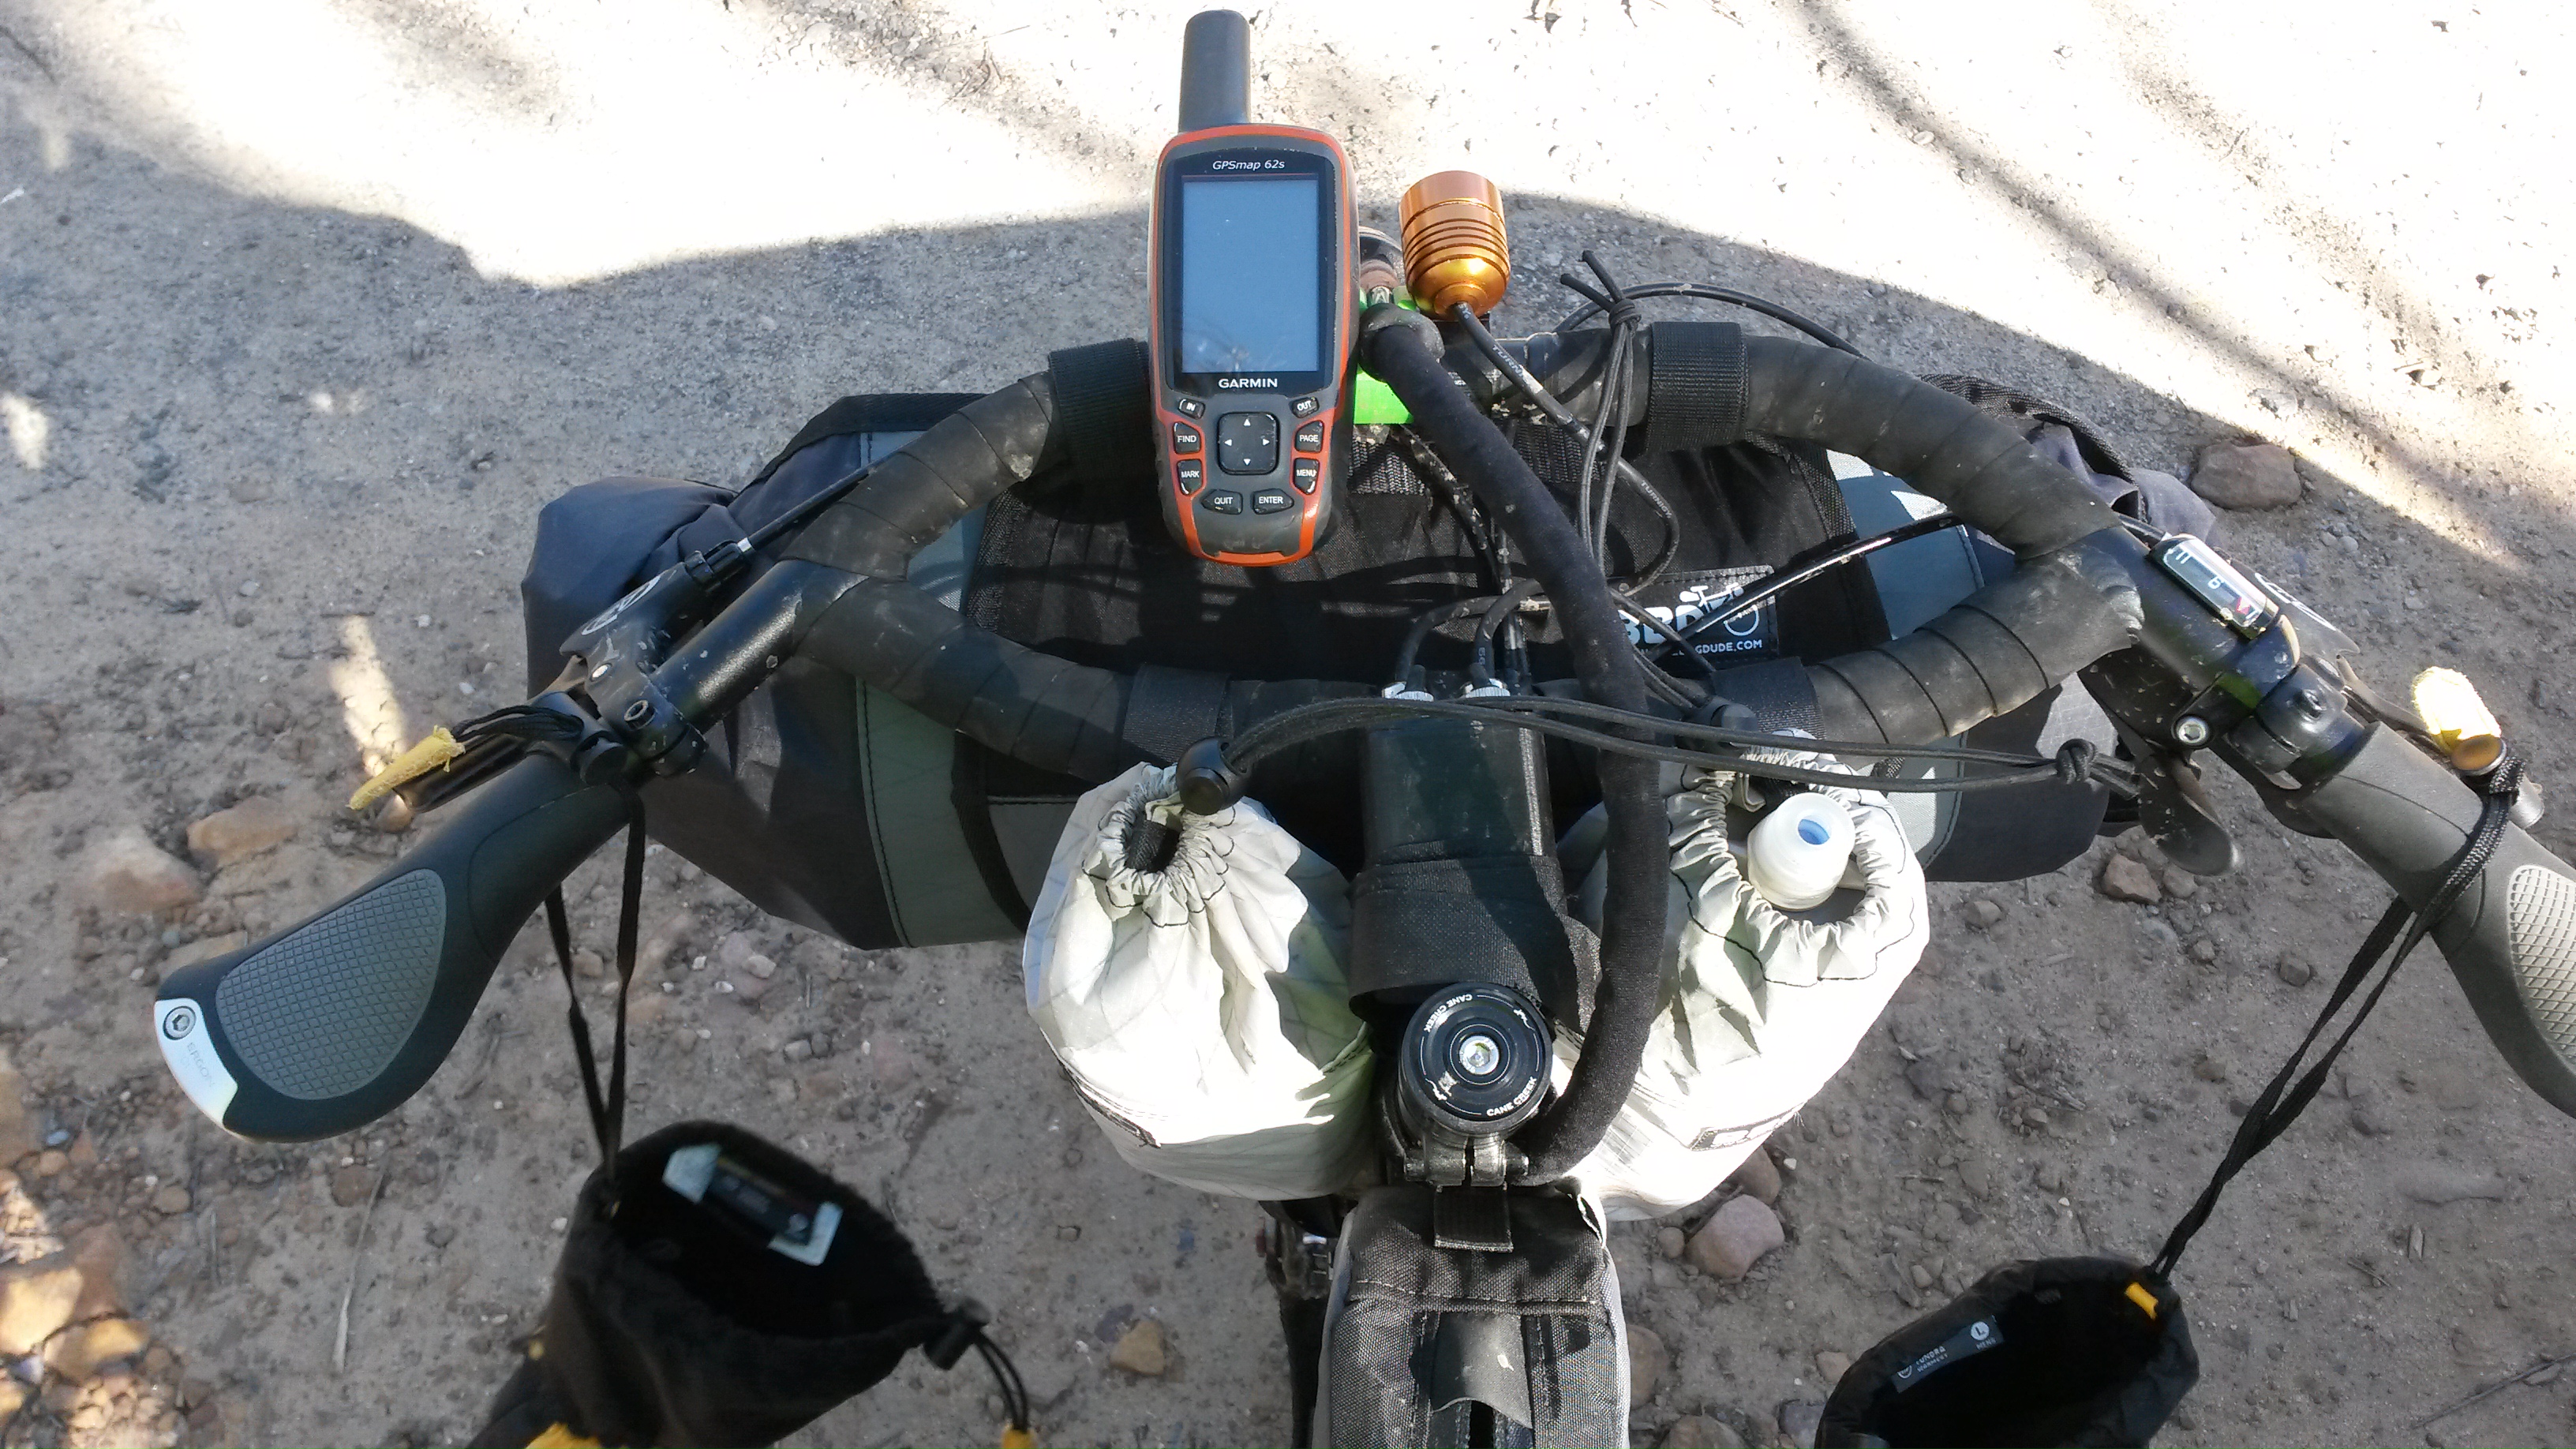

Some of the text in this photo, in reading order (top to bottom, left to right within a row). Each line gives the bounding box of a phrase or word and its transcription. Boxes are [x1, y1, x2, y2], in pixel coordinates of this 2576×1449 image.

[1212, 159, 1285, 170] GPSmap 62s
[1218, 378, 1278, 388] GARMIN
[1186, 402, 1196, 411] IN
[1297, 401, 1312, 411] OUT
[1299, 434, 1319, 443] PAGE
[1424, 994, 1473, 1032] CANE CREEK
[1487, 1076, 1537, 1117] CANE CREEK
